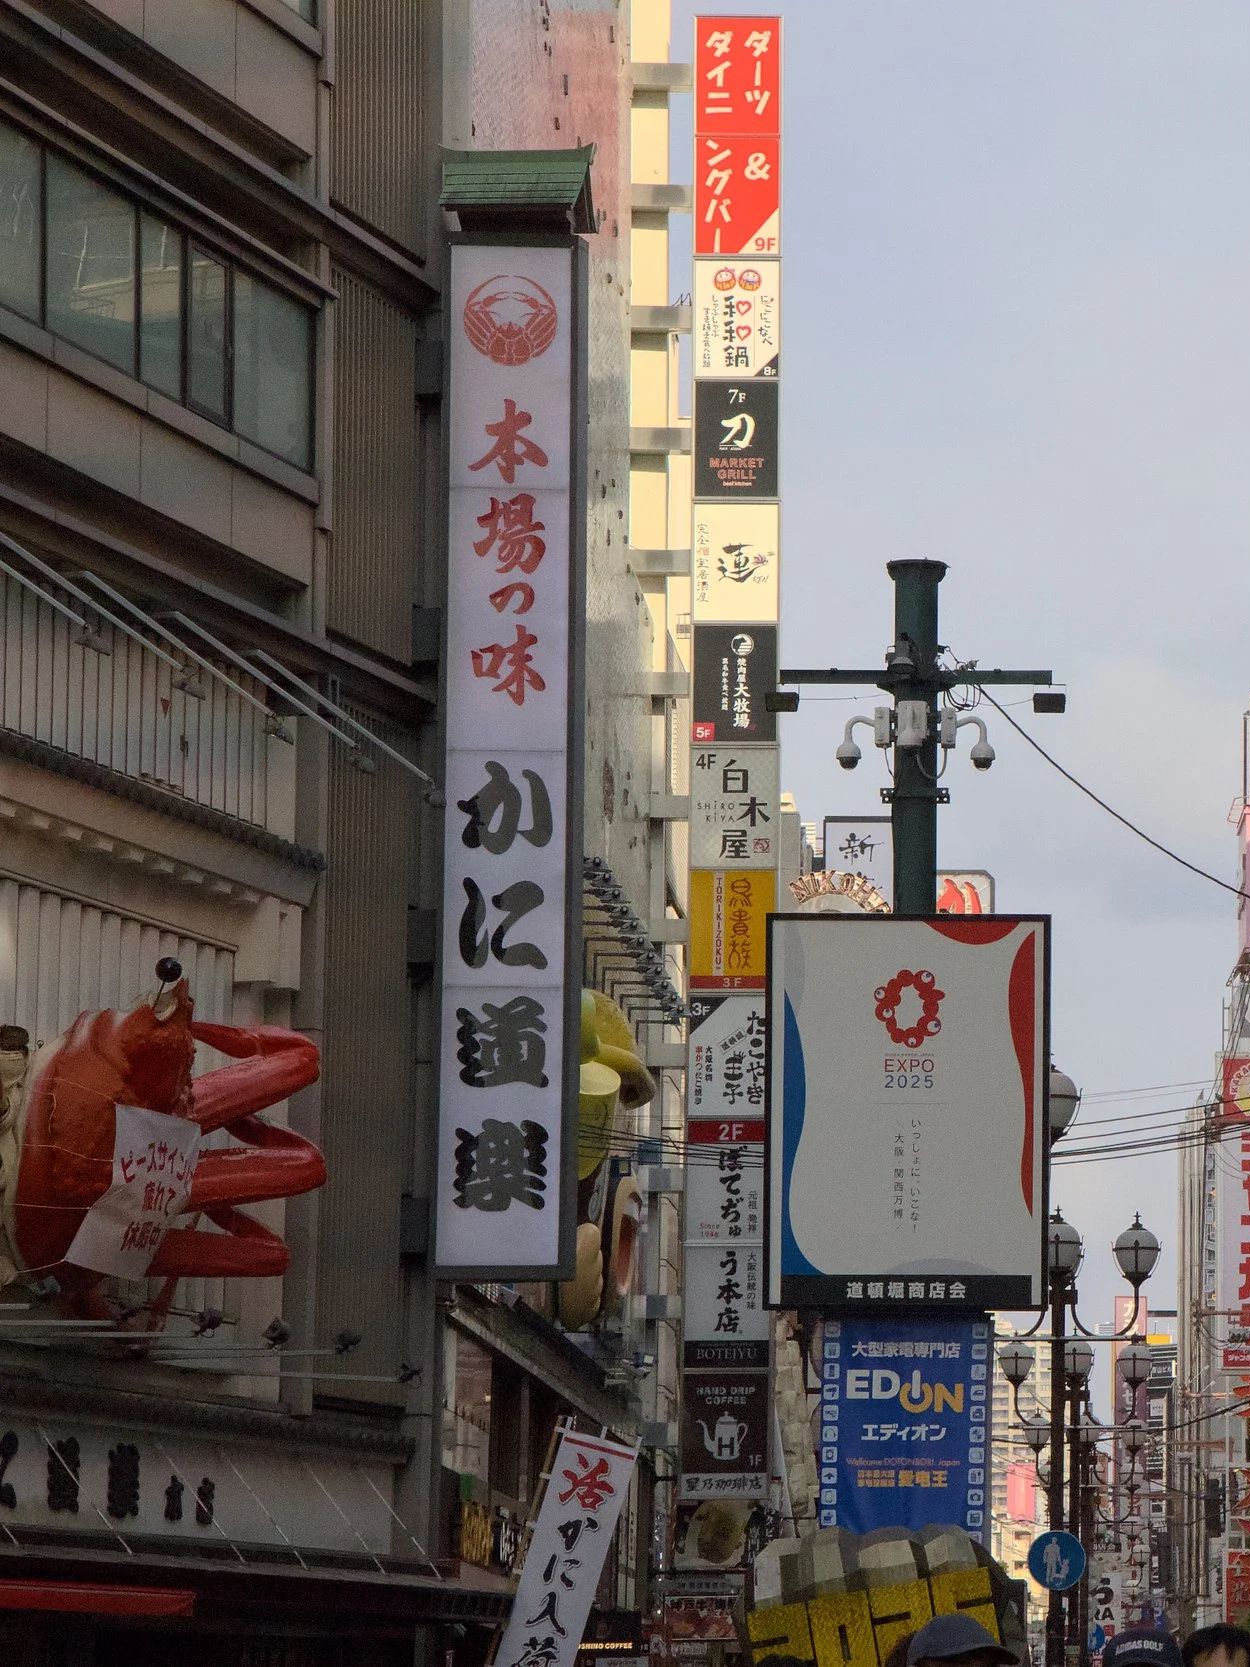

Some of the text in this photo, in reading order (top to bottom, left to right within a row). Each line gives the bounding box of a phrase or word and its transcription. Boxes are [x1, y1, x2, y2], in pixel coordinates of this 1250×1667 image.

[705, 30, 733, 254] ダイニングバー
[755, 237, 776, 251] 9F
[763, 367, 777, 376] 8F
[728, 389, 747, 404] 7F
[709, 458, 765, 468] MARKET
[717, 469, 757, 480] GRILL
[467, 398, 549, 706] 本場の味
[695, 727, 711, 739] 5F
[695, 754, 717, 770] 4F
[722, 977, 742, 987] 3F
[691, 1002, 711, 1016] 3F
[746, 1010, 766, 1104] たこやき
[884, 1058, 935, 1074] EXPO
[884, 1074, 935, 1090] 2025
[718, 1123, 744, 1141] 2F
[846, 1280, 967, 1299] 道頓堀商店会
[851, 1341, 961, 1359] 大型家電専門店
[696, 1386, 756, 1395] HAND DRIP
[846, 1369, 964, 1414] EDION
[705, 1396, 747, 1405] COFFEE
[861, 1423, 947, 1441] エディオン
[749, 1454, 762, 1466] 1F
[605, 1642, 633, 1650] COFFEE
